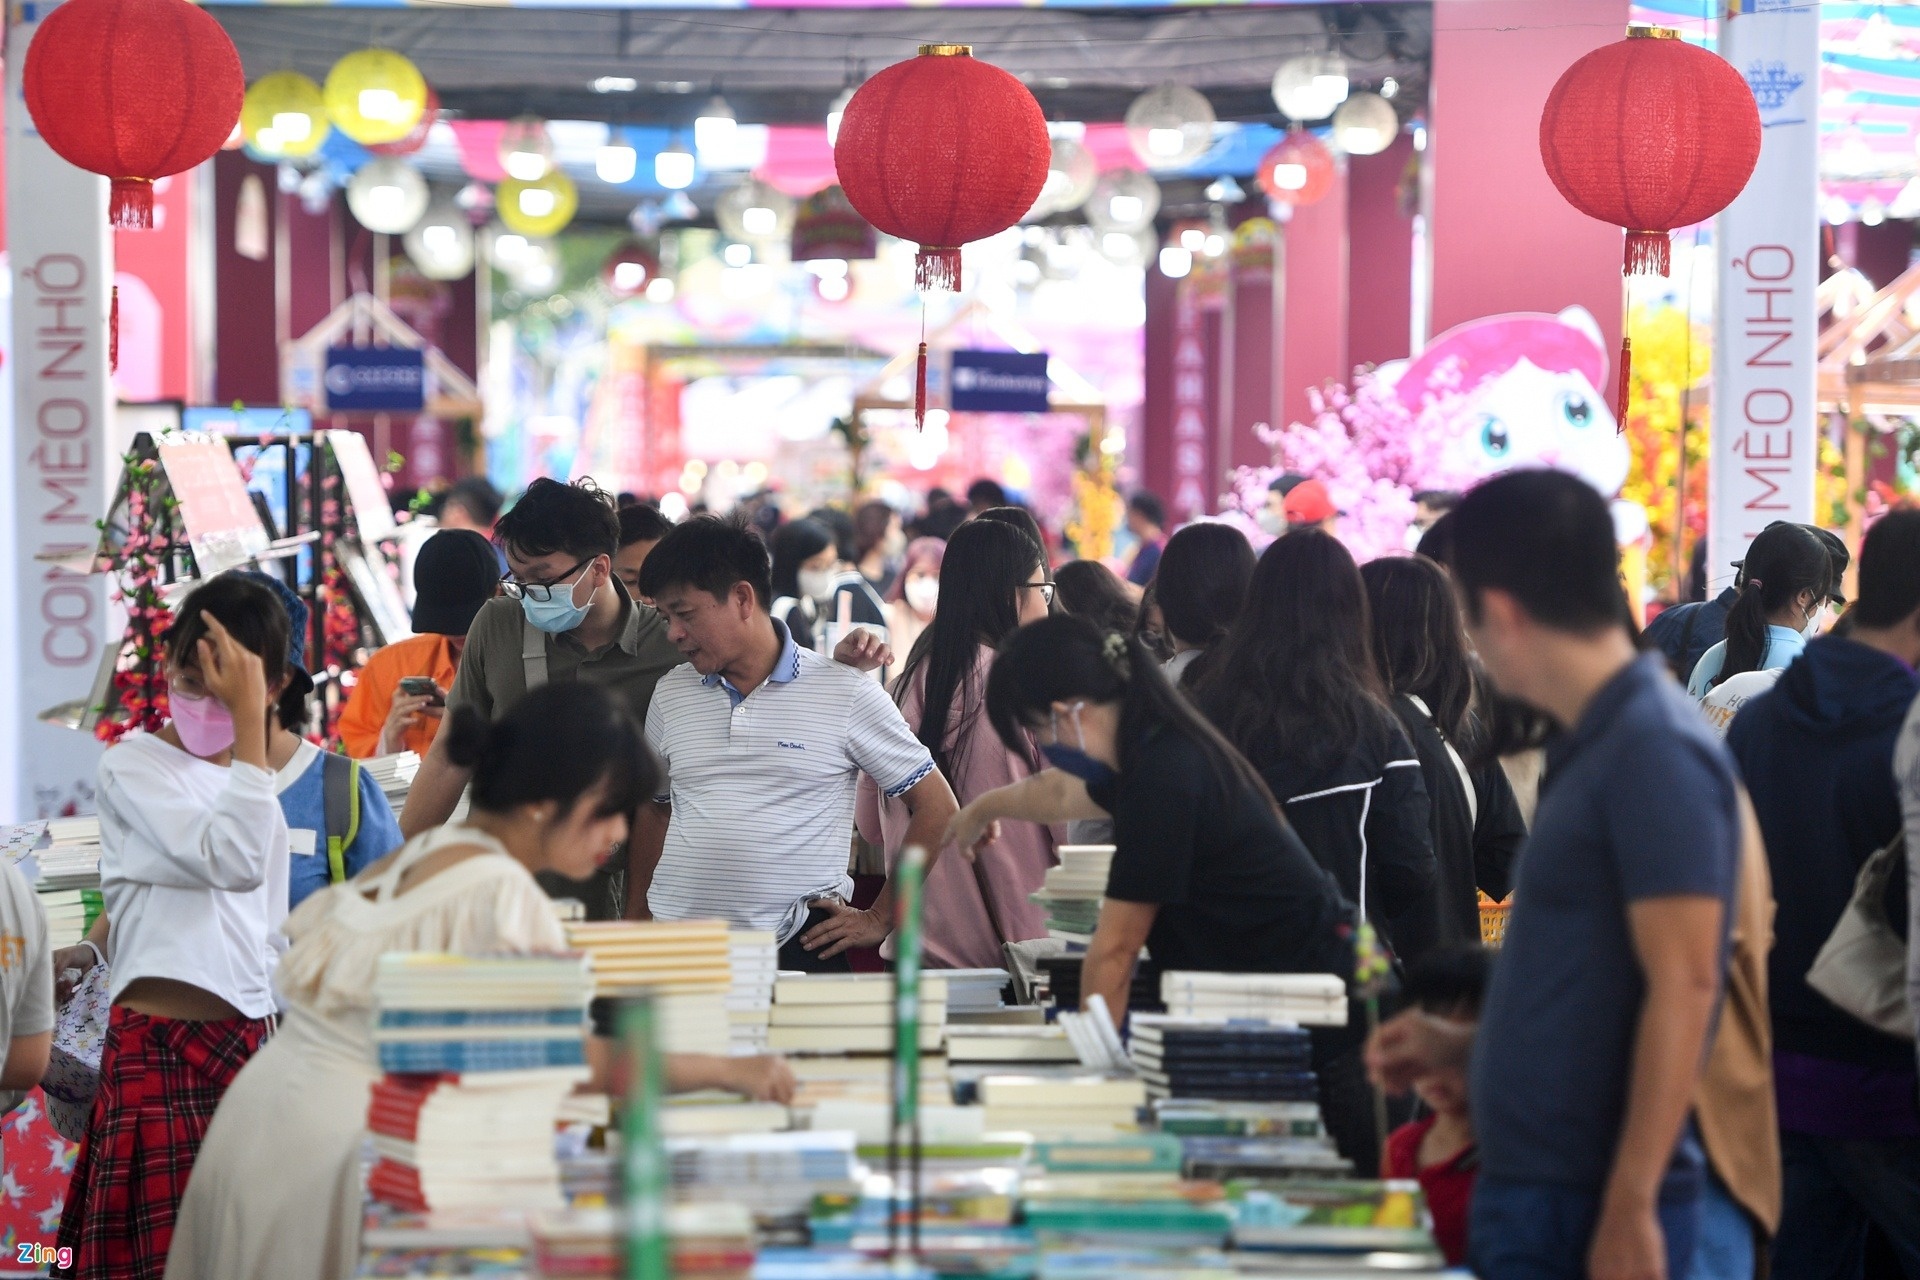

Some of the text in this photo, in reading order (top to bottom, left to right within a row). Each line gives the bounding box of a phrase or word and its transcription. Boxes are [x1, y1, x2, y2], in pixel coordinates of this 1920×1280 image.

[21, 253, 87, 380] NHỎ
[1731, 244, 1794, 509] MÈO NHỎ
[28, 398, 91, 524] MÈO
